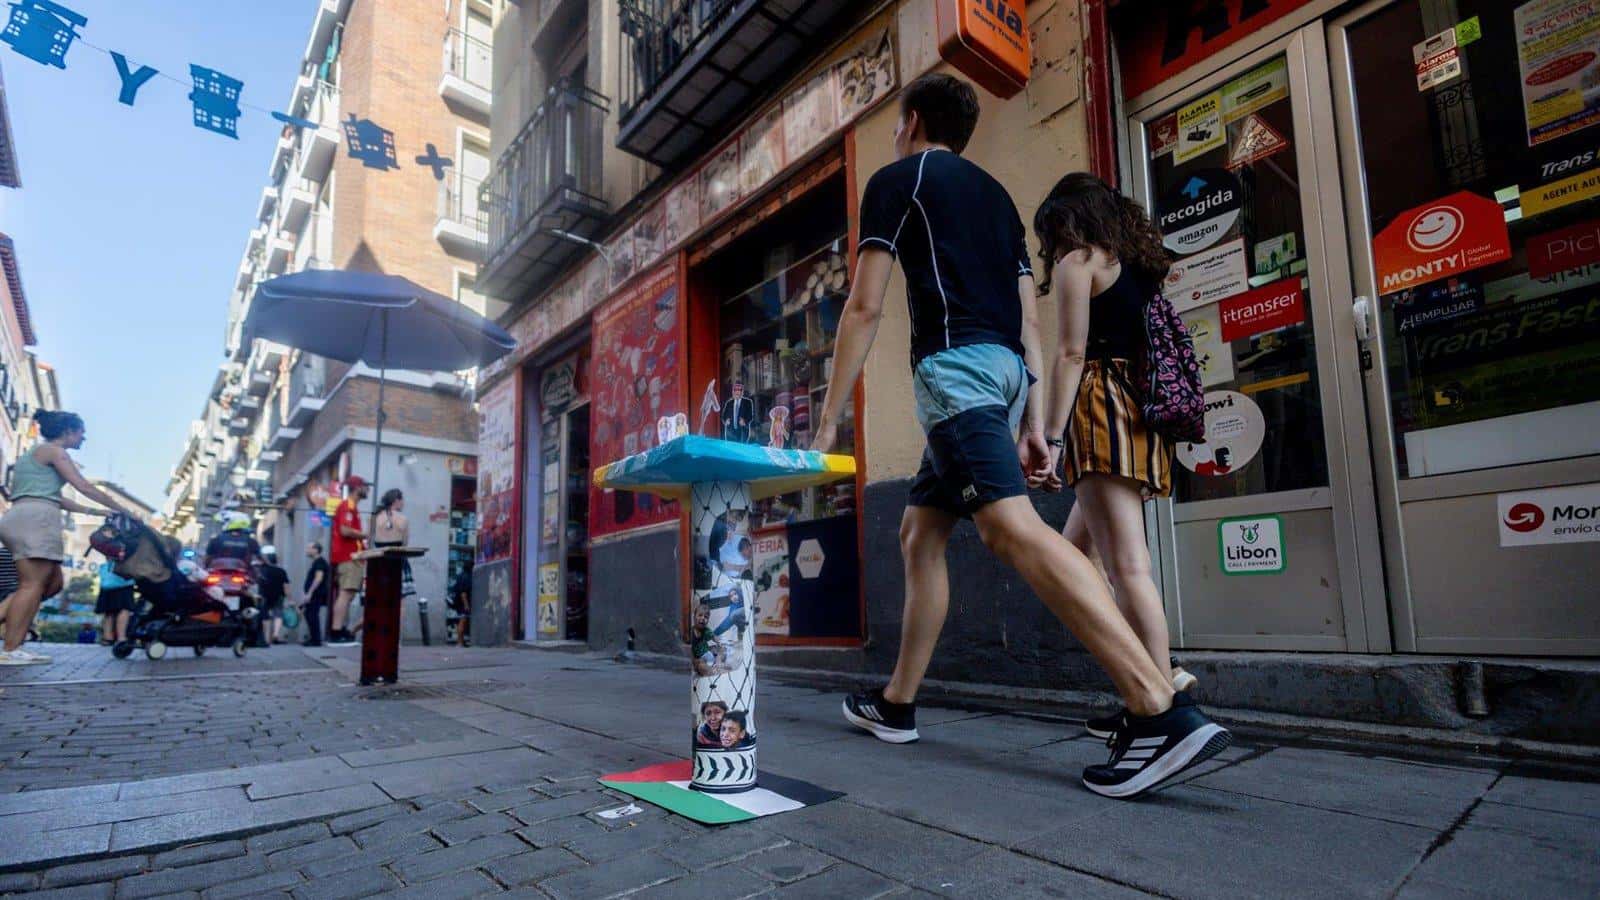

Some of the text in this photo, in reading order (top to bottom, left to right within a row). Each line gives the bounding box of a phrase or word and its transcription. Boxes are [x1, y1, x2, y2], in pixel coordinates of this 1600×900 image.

[1418, 49, 1456, 70] Alarma
[1180, 99, 1216, 120] ALARMA
[1541, 151, 1594, 177] Trans
[1543, 183, 1579, 202] AGENTE
[1161, 189, 1233, 226] recogida
[1178, 223, 1218, 244] amazon
[1467, 243, 1491, 255] Global
[1547, 227, 1600, 262] Pic
[1468, 249, 1505, 264] Payments
[1383, 254, 1459, 288] MONTY
[1203, 394, 1234, 412] owi
[752, 538, 785, 554] TERIA
[1227, 546, 1277, 560] Libon
